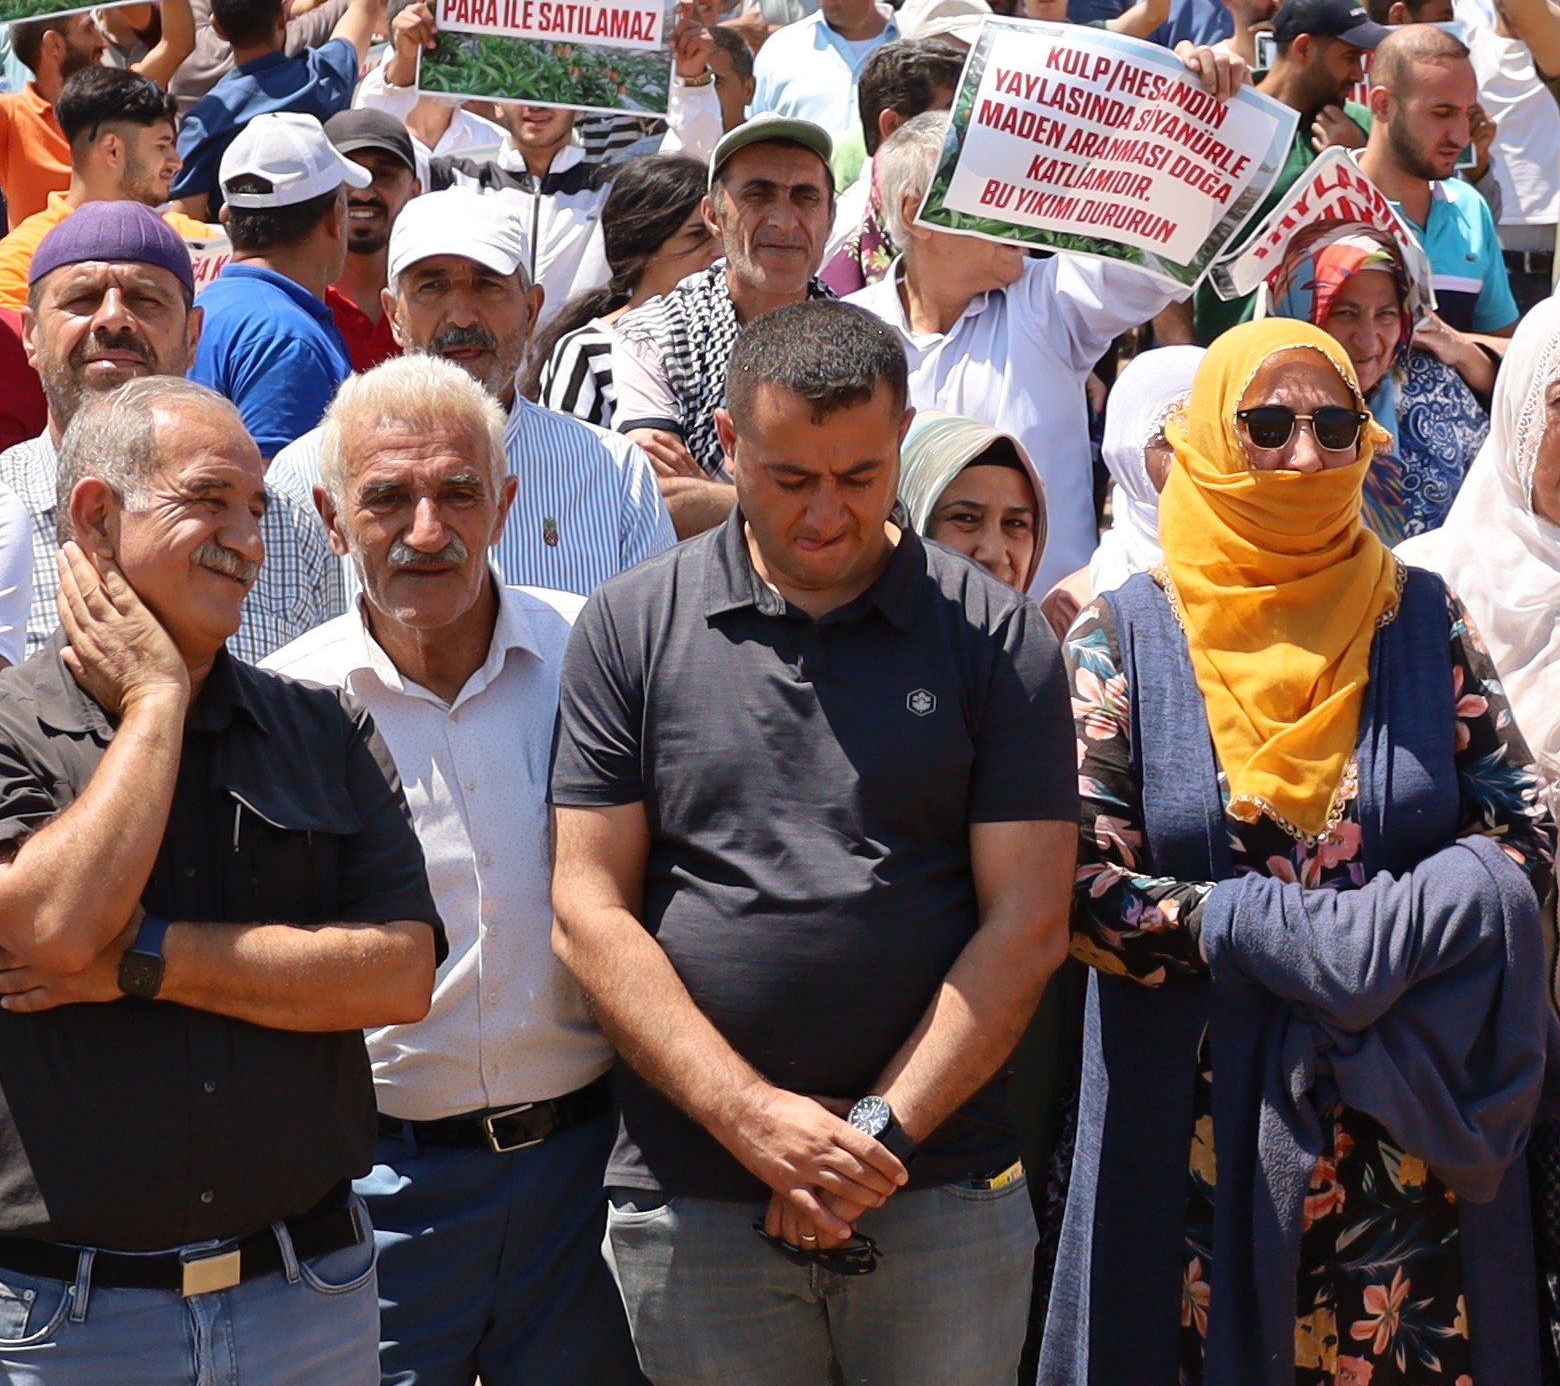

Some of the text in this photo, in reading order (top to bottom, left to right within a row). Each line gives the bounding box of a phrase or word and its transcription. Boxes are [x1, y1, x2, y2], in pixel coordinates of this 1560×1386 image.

[538, 1, 658, 43] SATILAMAZ
[977, 99, 1233, 206] MADEN ARANMASI DOĞA
[994, 67, 1252, 180] YAYLASINDA SİYANÜRLE
[980, 178, 1179, 244] BU YIKIMI DURURUN
[1026, 154, 1154, 203] KATLİAMIDIR.
